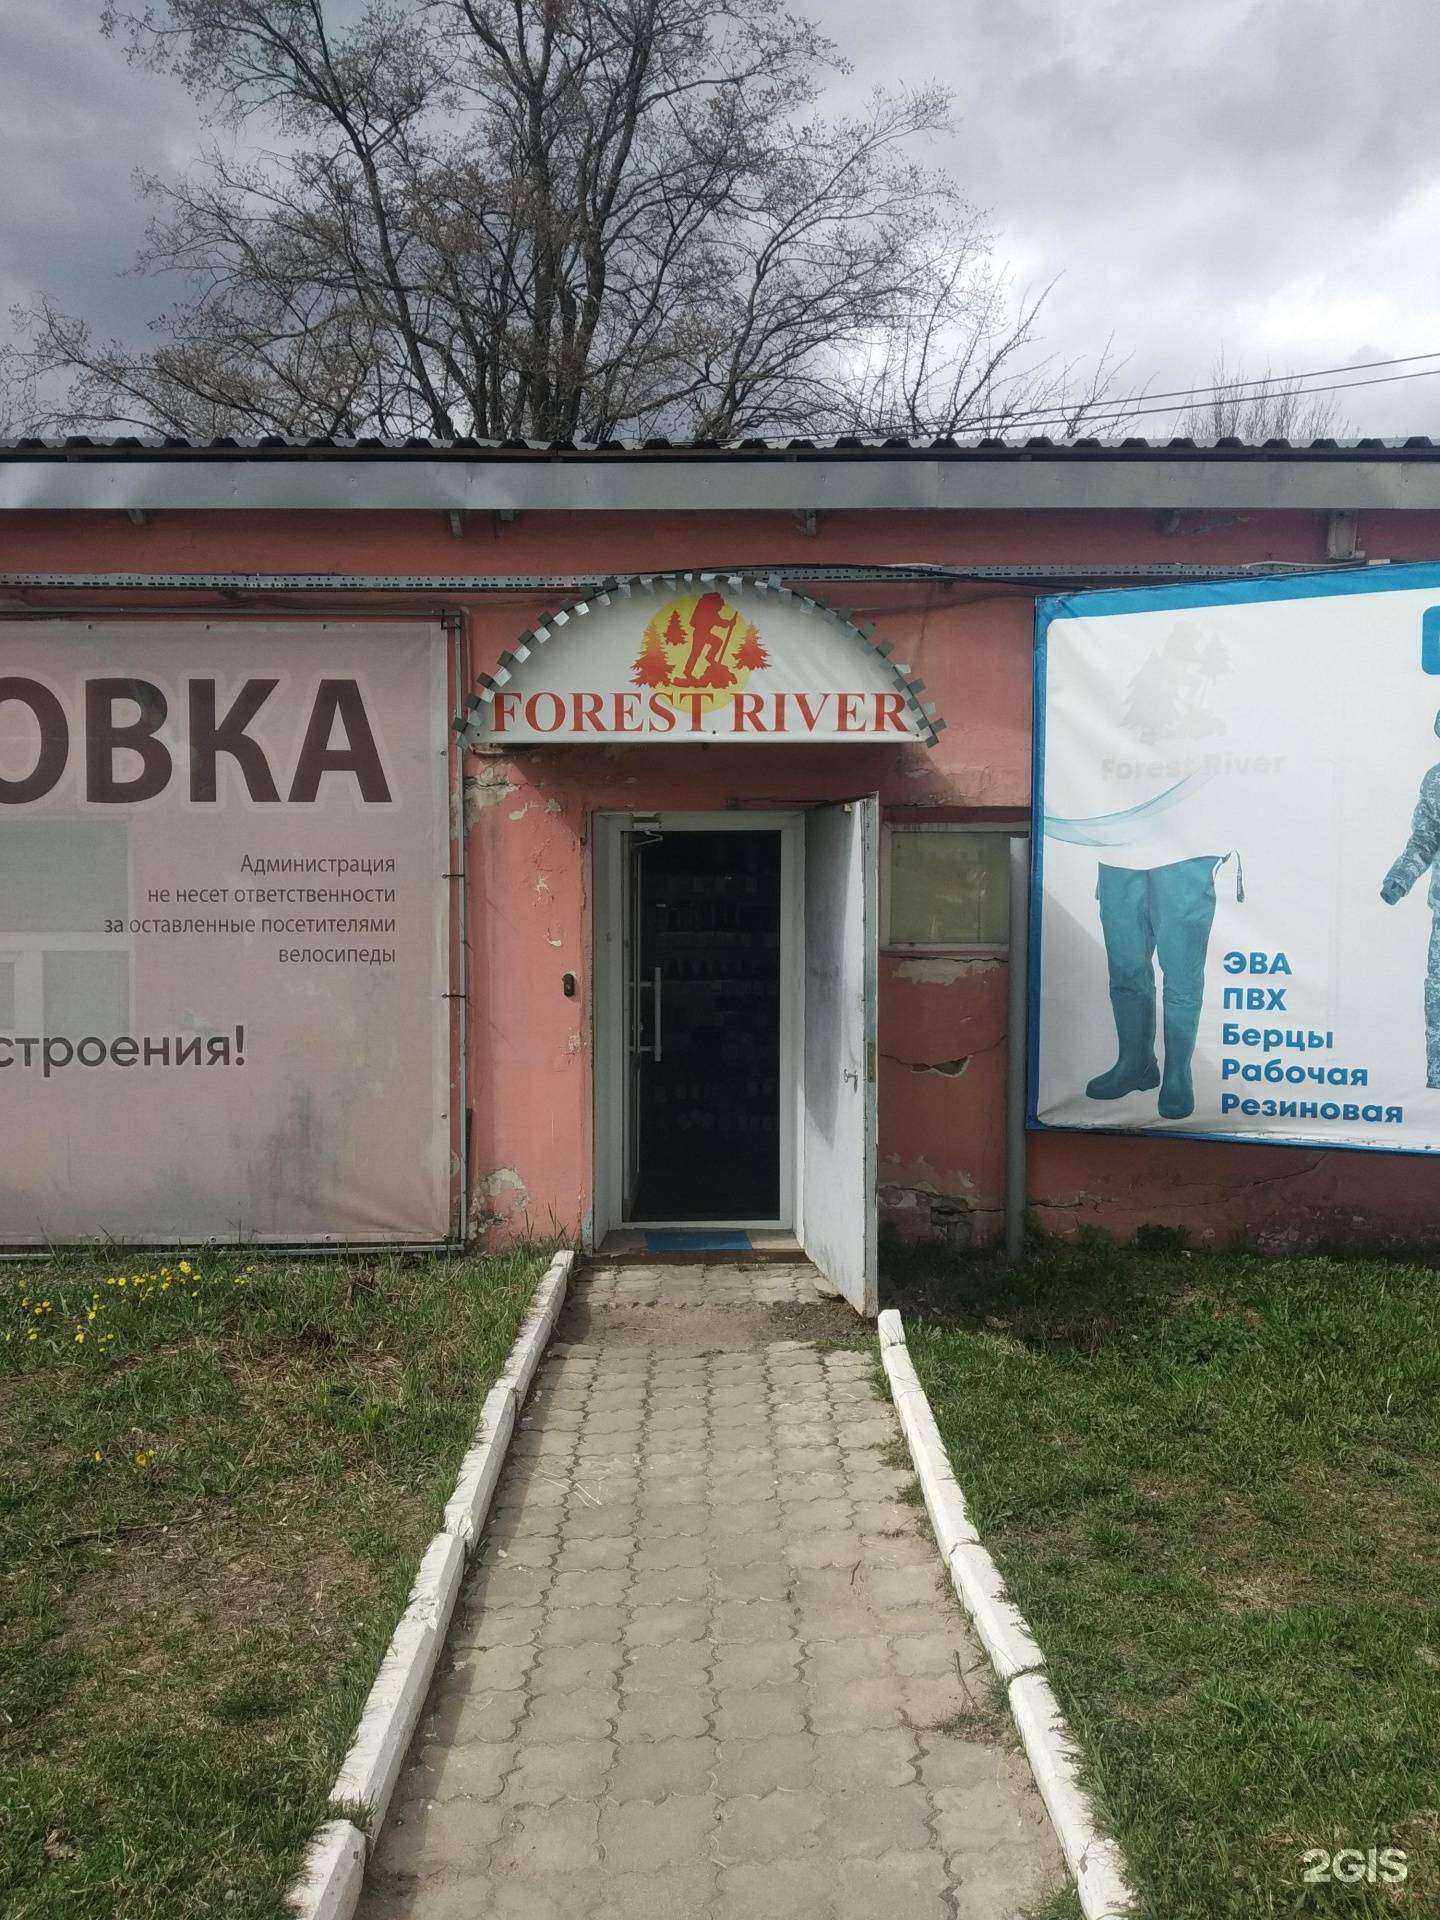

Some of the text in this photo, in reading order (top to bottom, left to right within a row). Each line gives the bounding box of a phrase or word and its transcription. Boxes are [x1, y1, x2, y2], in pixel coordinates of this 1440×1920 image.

[490, 692, 913, 734] FOREST RIVER
[241, 854, 397, 877] Администрация
[148, 887, 396, 904] не несет ответственности
[103, 918, 396, 934] за оставленные посетителями
[278, 947, 396, 966] велосипеды
[1223, 951, 1292, 976] ЭВА
[1223, 987, 1288, 1012] ПВХ
[1222, 1022, 1334, 1052] Берцы
[1221, 1058, 1369, 1087] Рабочая
[1221, 1092, 1404, 1125] Резиновая
